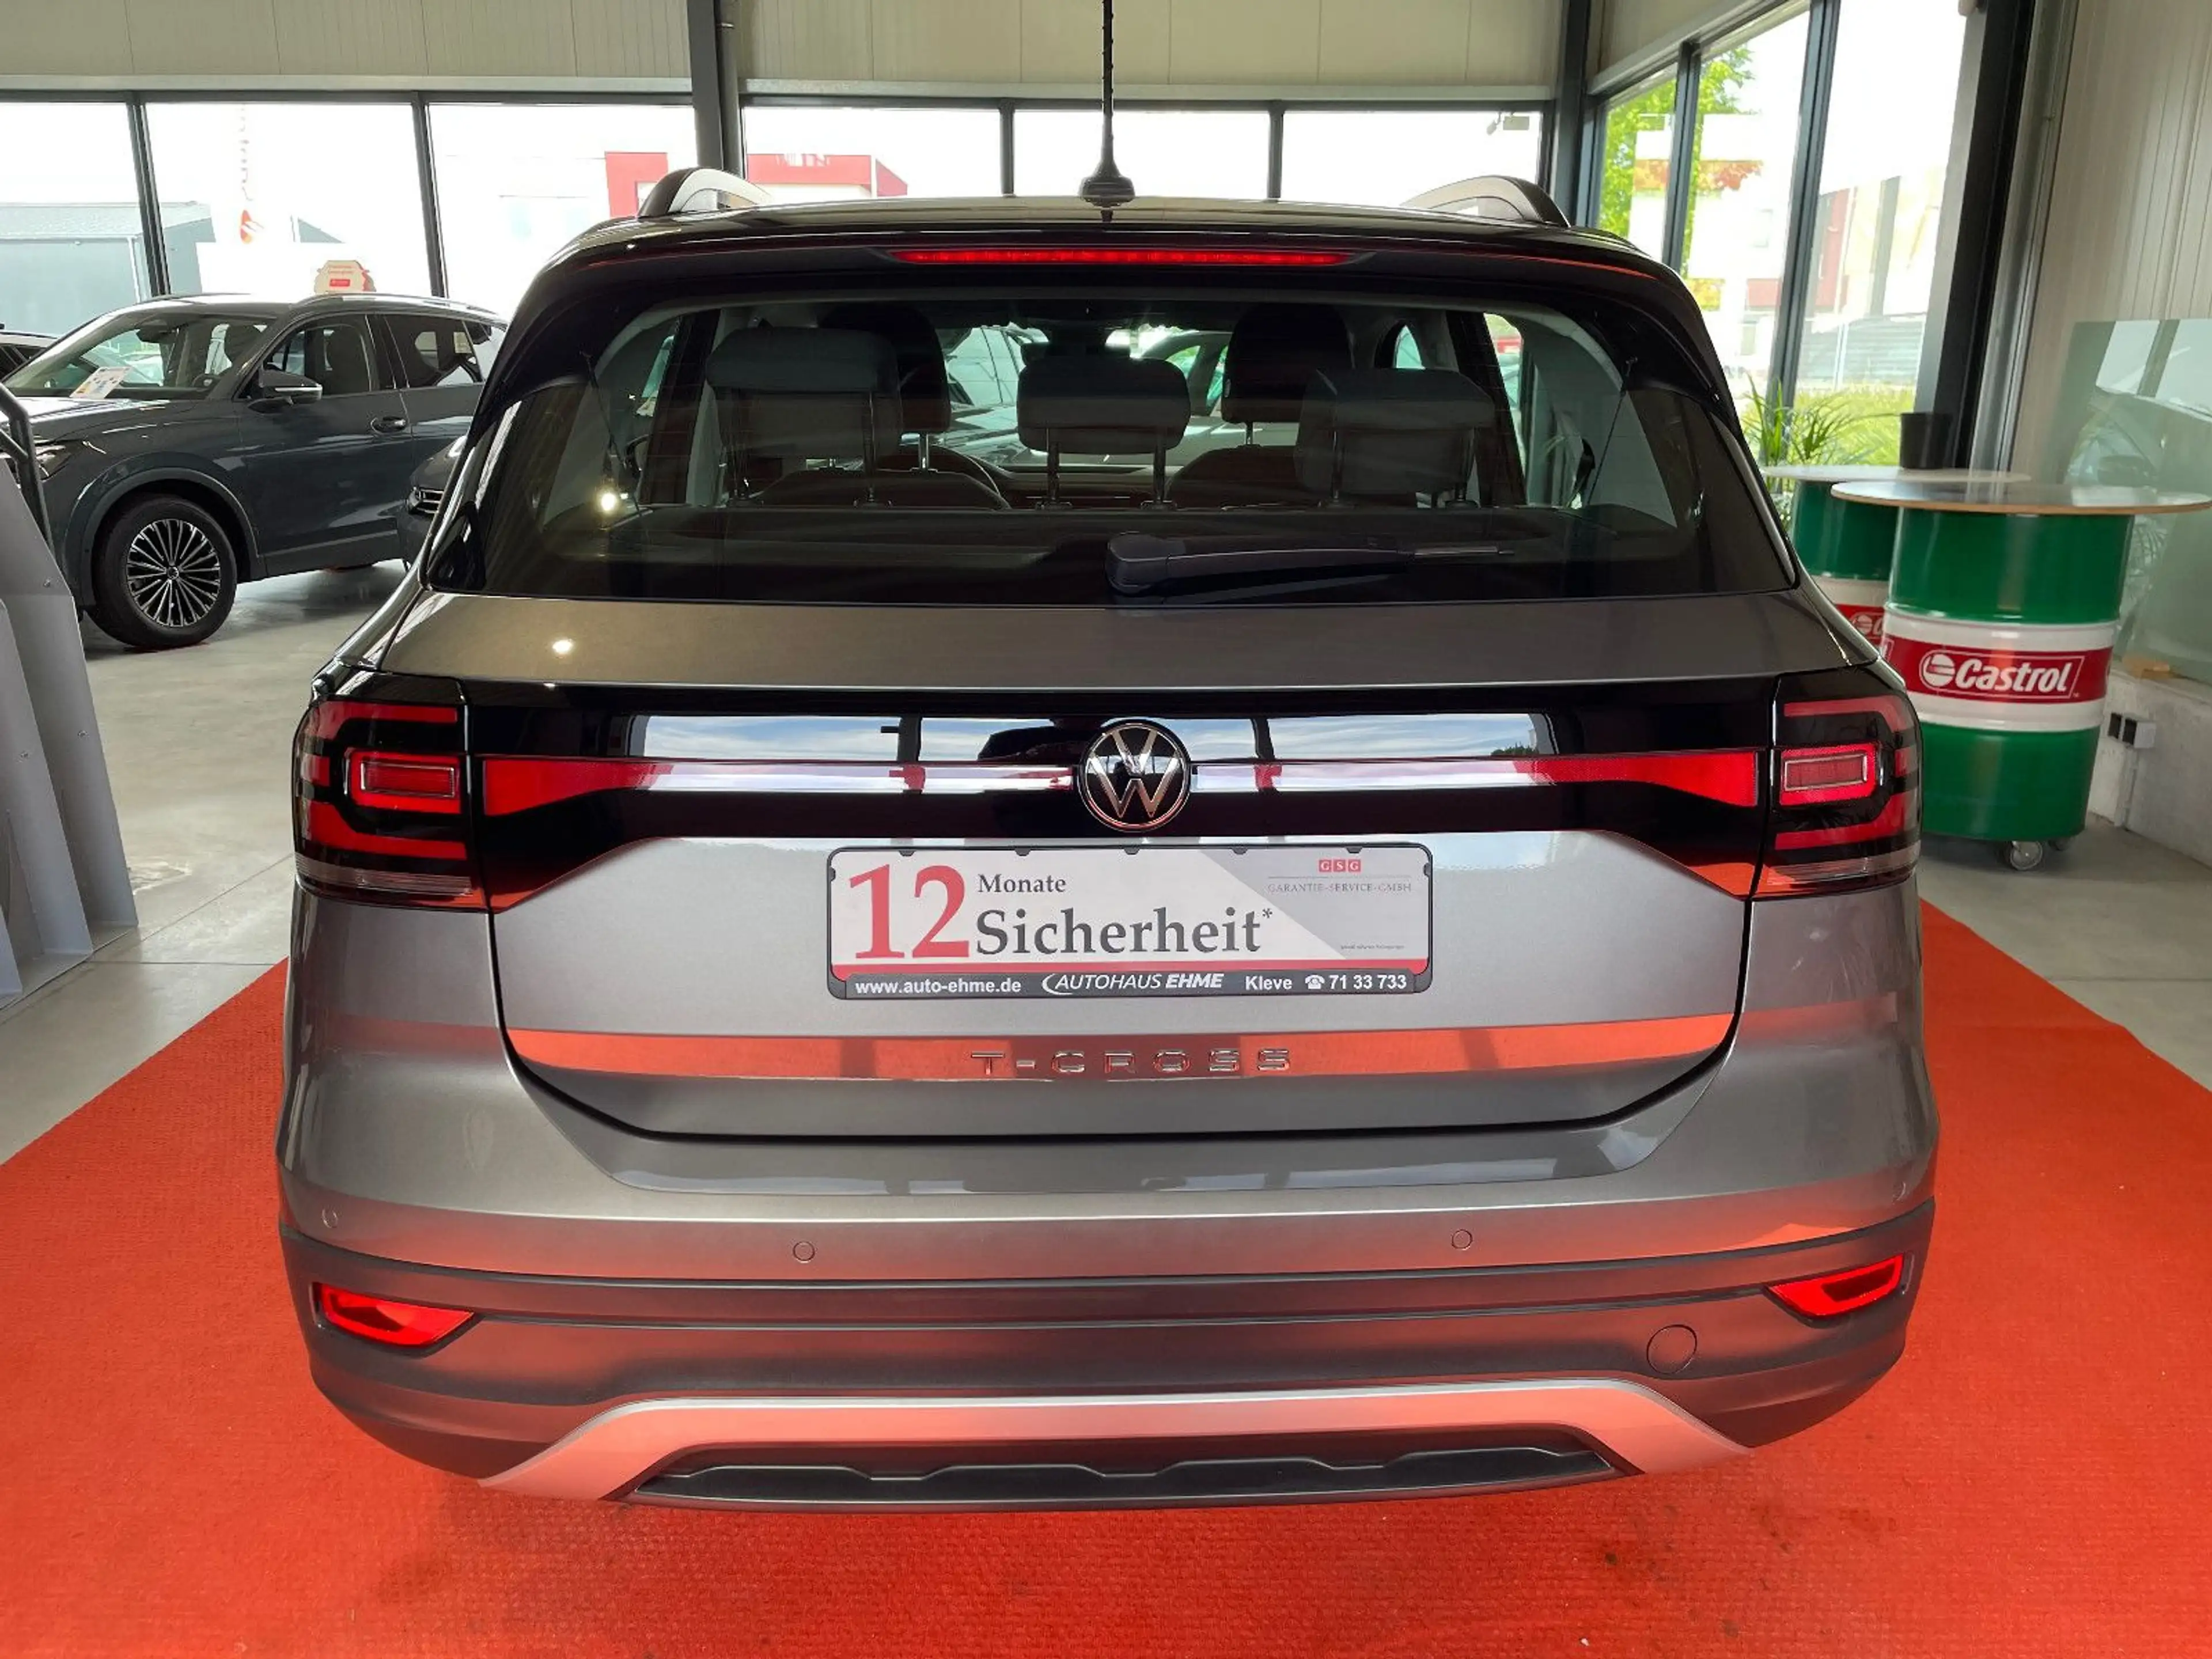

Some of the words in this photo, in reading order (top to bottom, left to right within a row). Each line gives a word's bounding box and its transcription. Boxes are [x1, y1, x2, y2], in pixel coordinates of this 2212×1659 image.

[1955, 658, 2073, 692] Castrol
[1319, 859, 1361, 872] GSG
[978, 874, 1066, 893] Monate
[849, 864, 969, 959] 12
[855, 978, 1021, 994] www.auto-ehme.de
[1055, 974, 1162, 990] AUTOHAUS
[1165, 973, 1224, 988] EHME
[1245, 976, 1293, 990] Kleve
[1328, 975, 1347, 989] 71
[1353, 975, 1372, 989] 33
[1377, 975, 1407, 989] 733
[971, 1048, 1290, 1075] T-CROSS
